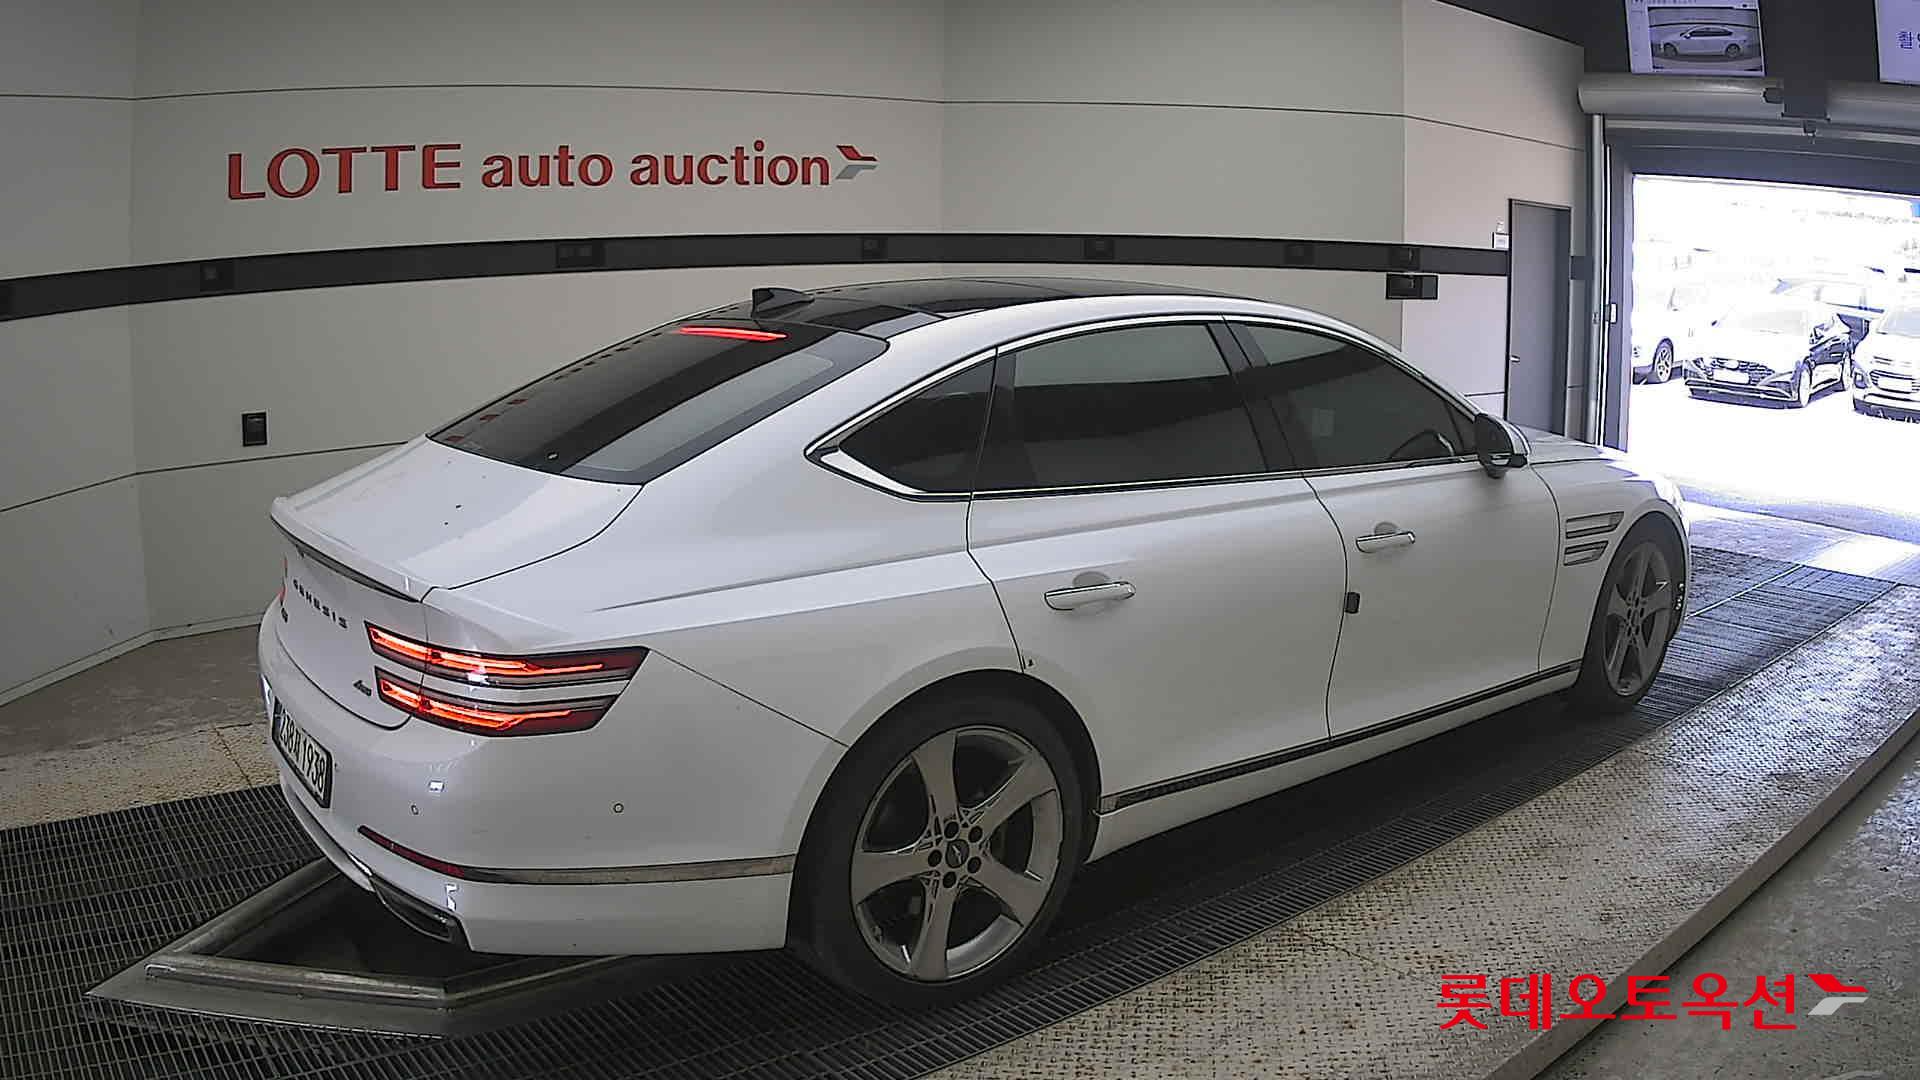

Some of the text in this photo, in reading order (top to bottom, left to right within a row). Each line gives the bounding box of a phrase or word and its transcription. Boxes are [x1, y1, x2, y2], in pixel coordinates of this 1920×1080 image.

[227, 140, 831, 200] LOTTE auto auction
